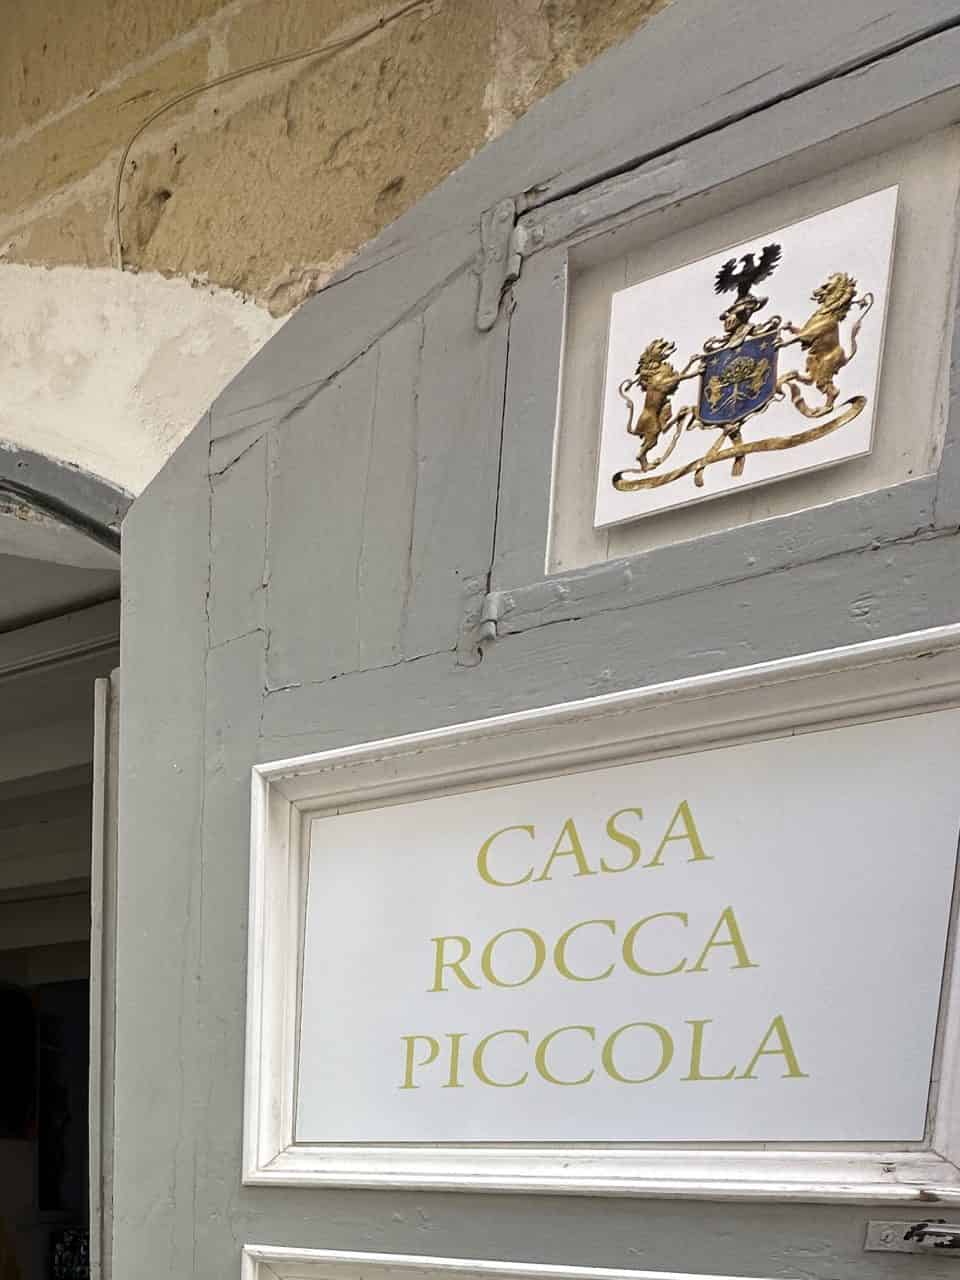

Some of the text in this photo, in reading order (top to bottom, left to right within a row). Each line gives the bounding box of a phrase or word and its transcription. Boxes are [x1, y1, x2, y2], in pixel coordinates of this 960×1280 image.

[477, 800, 715, 888] CASA
[427, 905, 760, 993] ROCCA
[398, 1014, 809, 1090] PICCOLA
